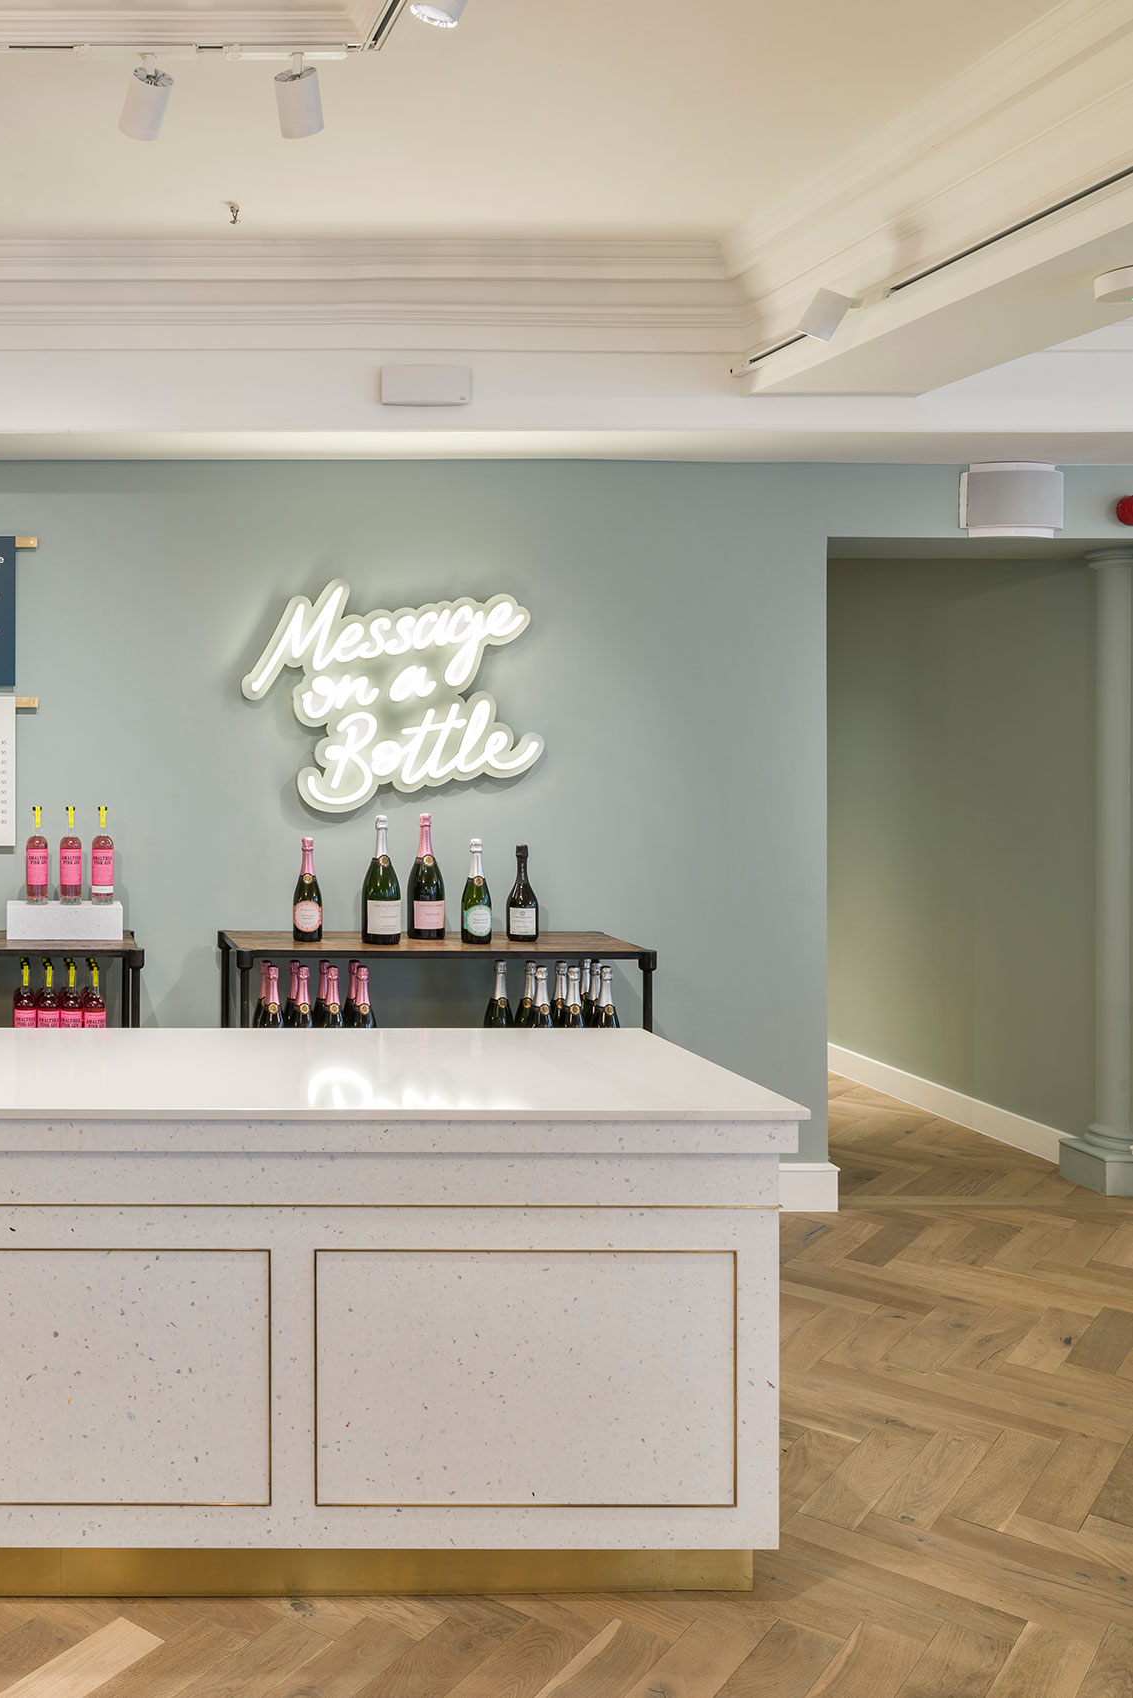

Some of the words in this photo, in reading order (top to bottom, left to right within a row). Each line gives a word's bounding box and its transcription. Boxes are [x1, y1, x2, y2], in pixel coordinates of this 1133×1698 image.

[249, 584, 527, 693] Message
[301, 674, 380, 720] on
[388, 665, 438, 702] a
[307, 699, 540, 805] Bottle
